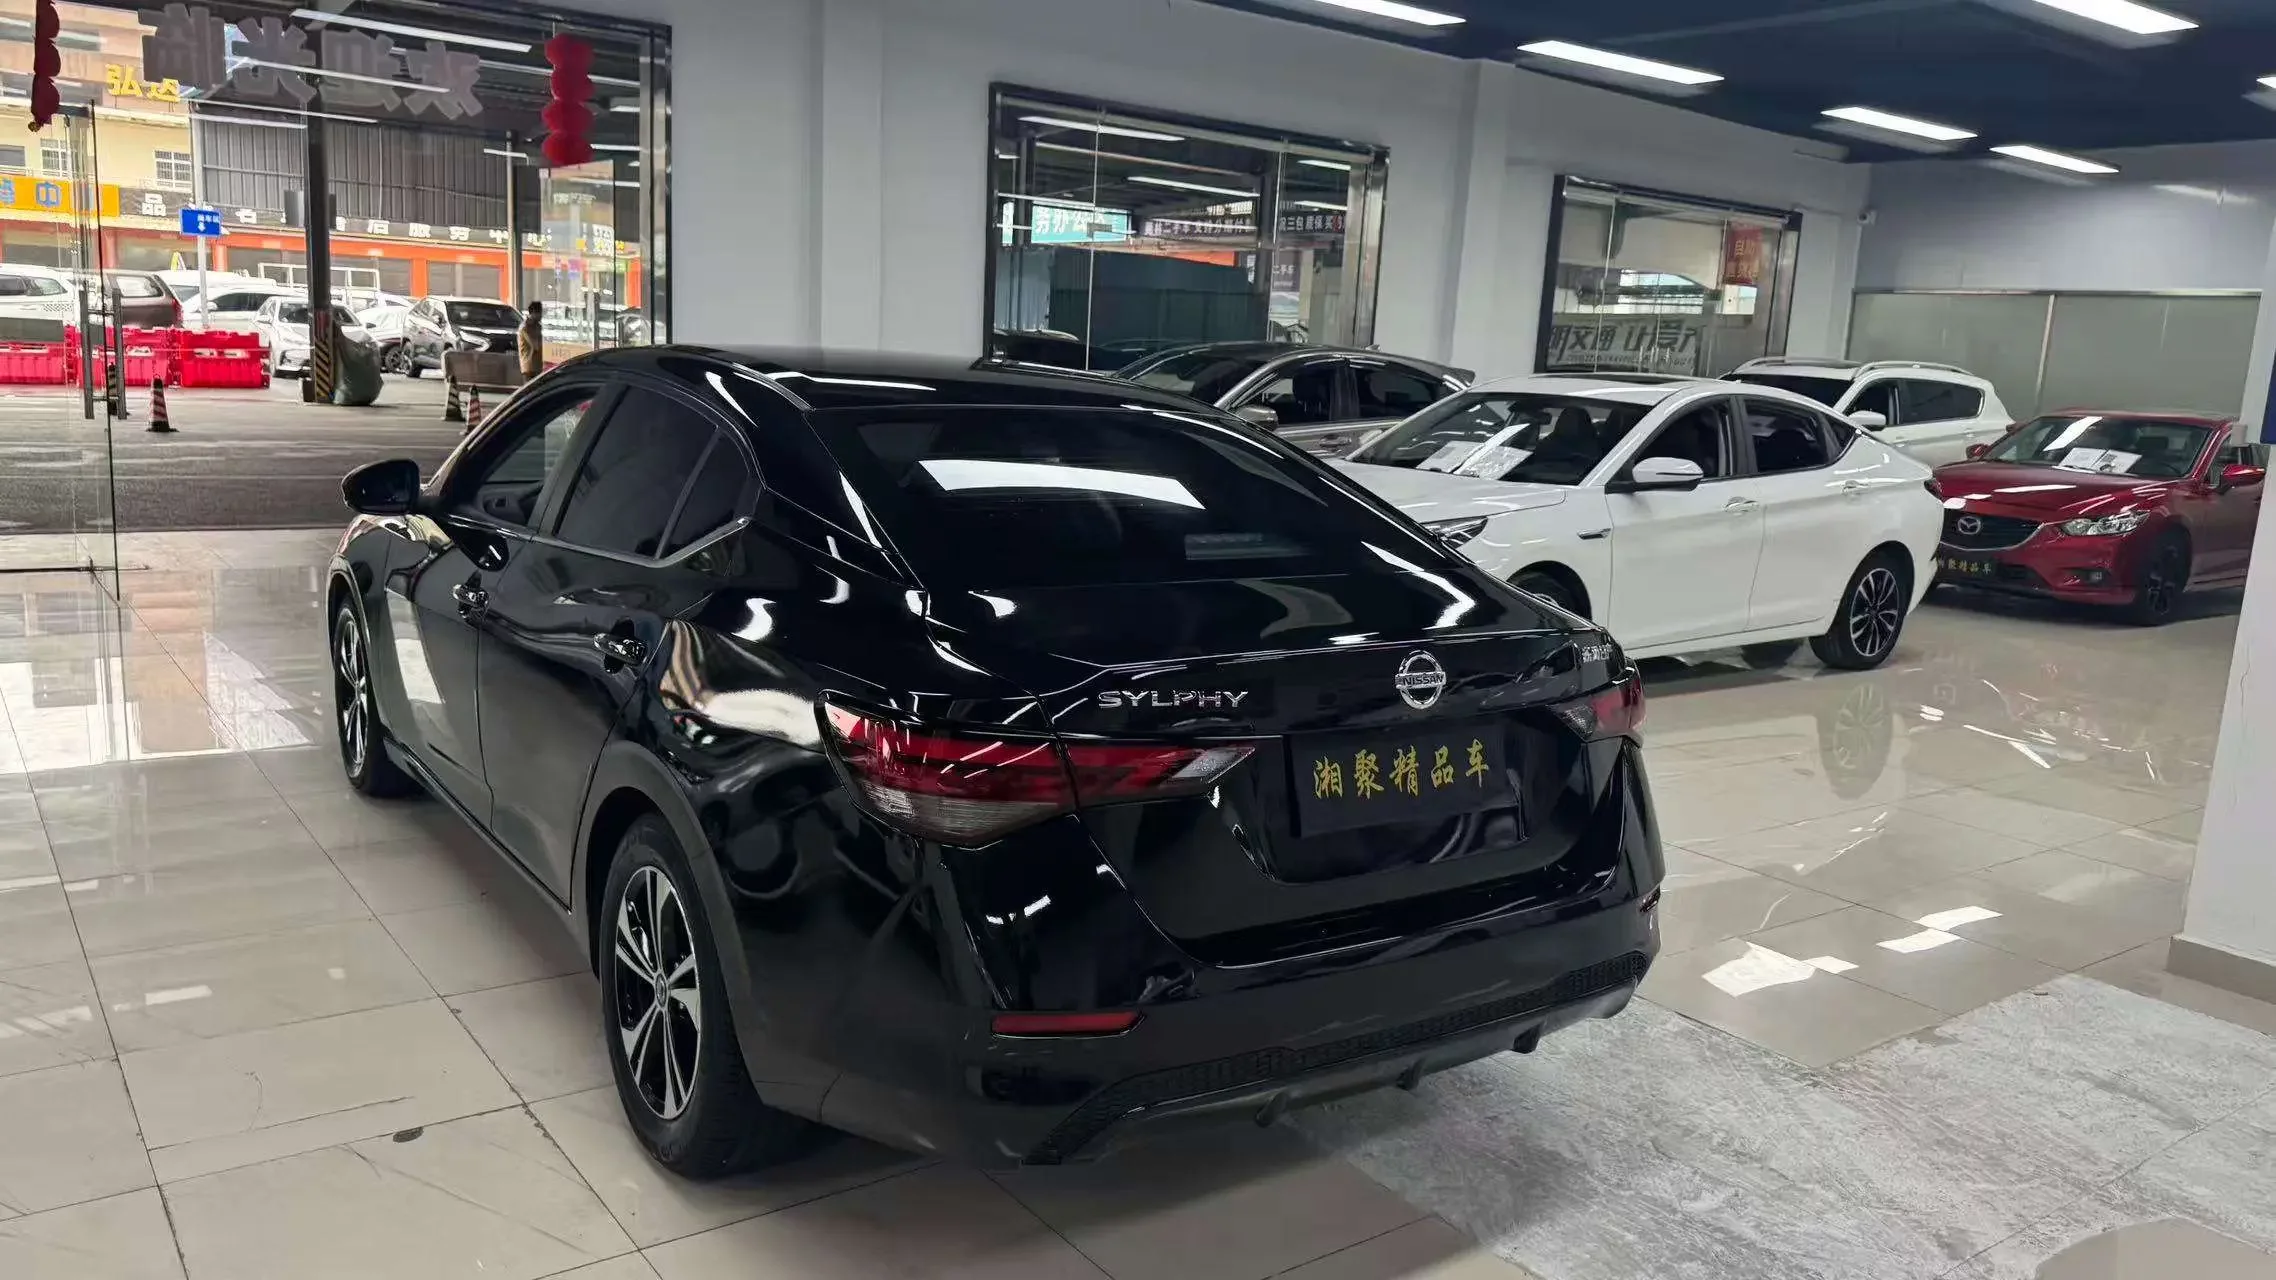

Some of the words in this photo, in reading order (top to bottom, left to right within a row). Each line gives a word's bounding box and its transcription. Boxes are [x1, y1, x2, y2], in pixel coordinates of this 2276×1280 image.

[1402, 674, 1444, 686] NISSAN
[1097, 690, 1249, 709] SYLPHY
[1313, 738, 1490, 800] 湘聚精品车
